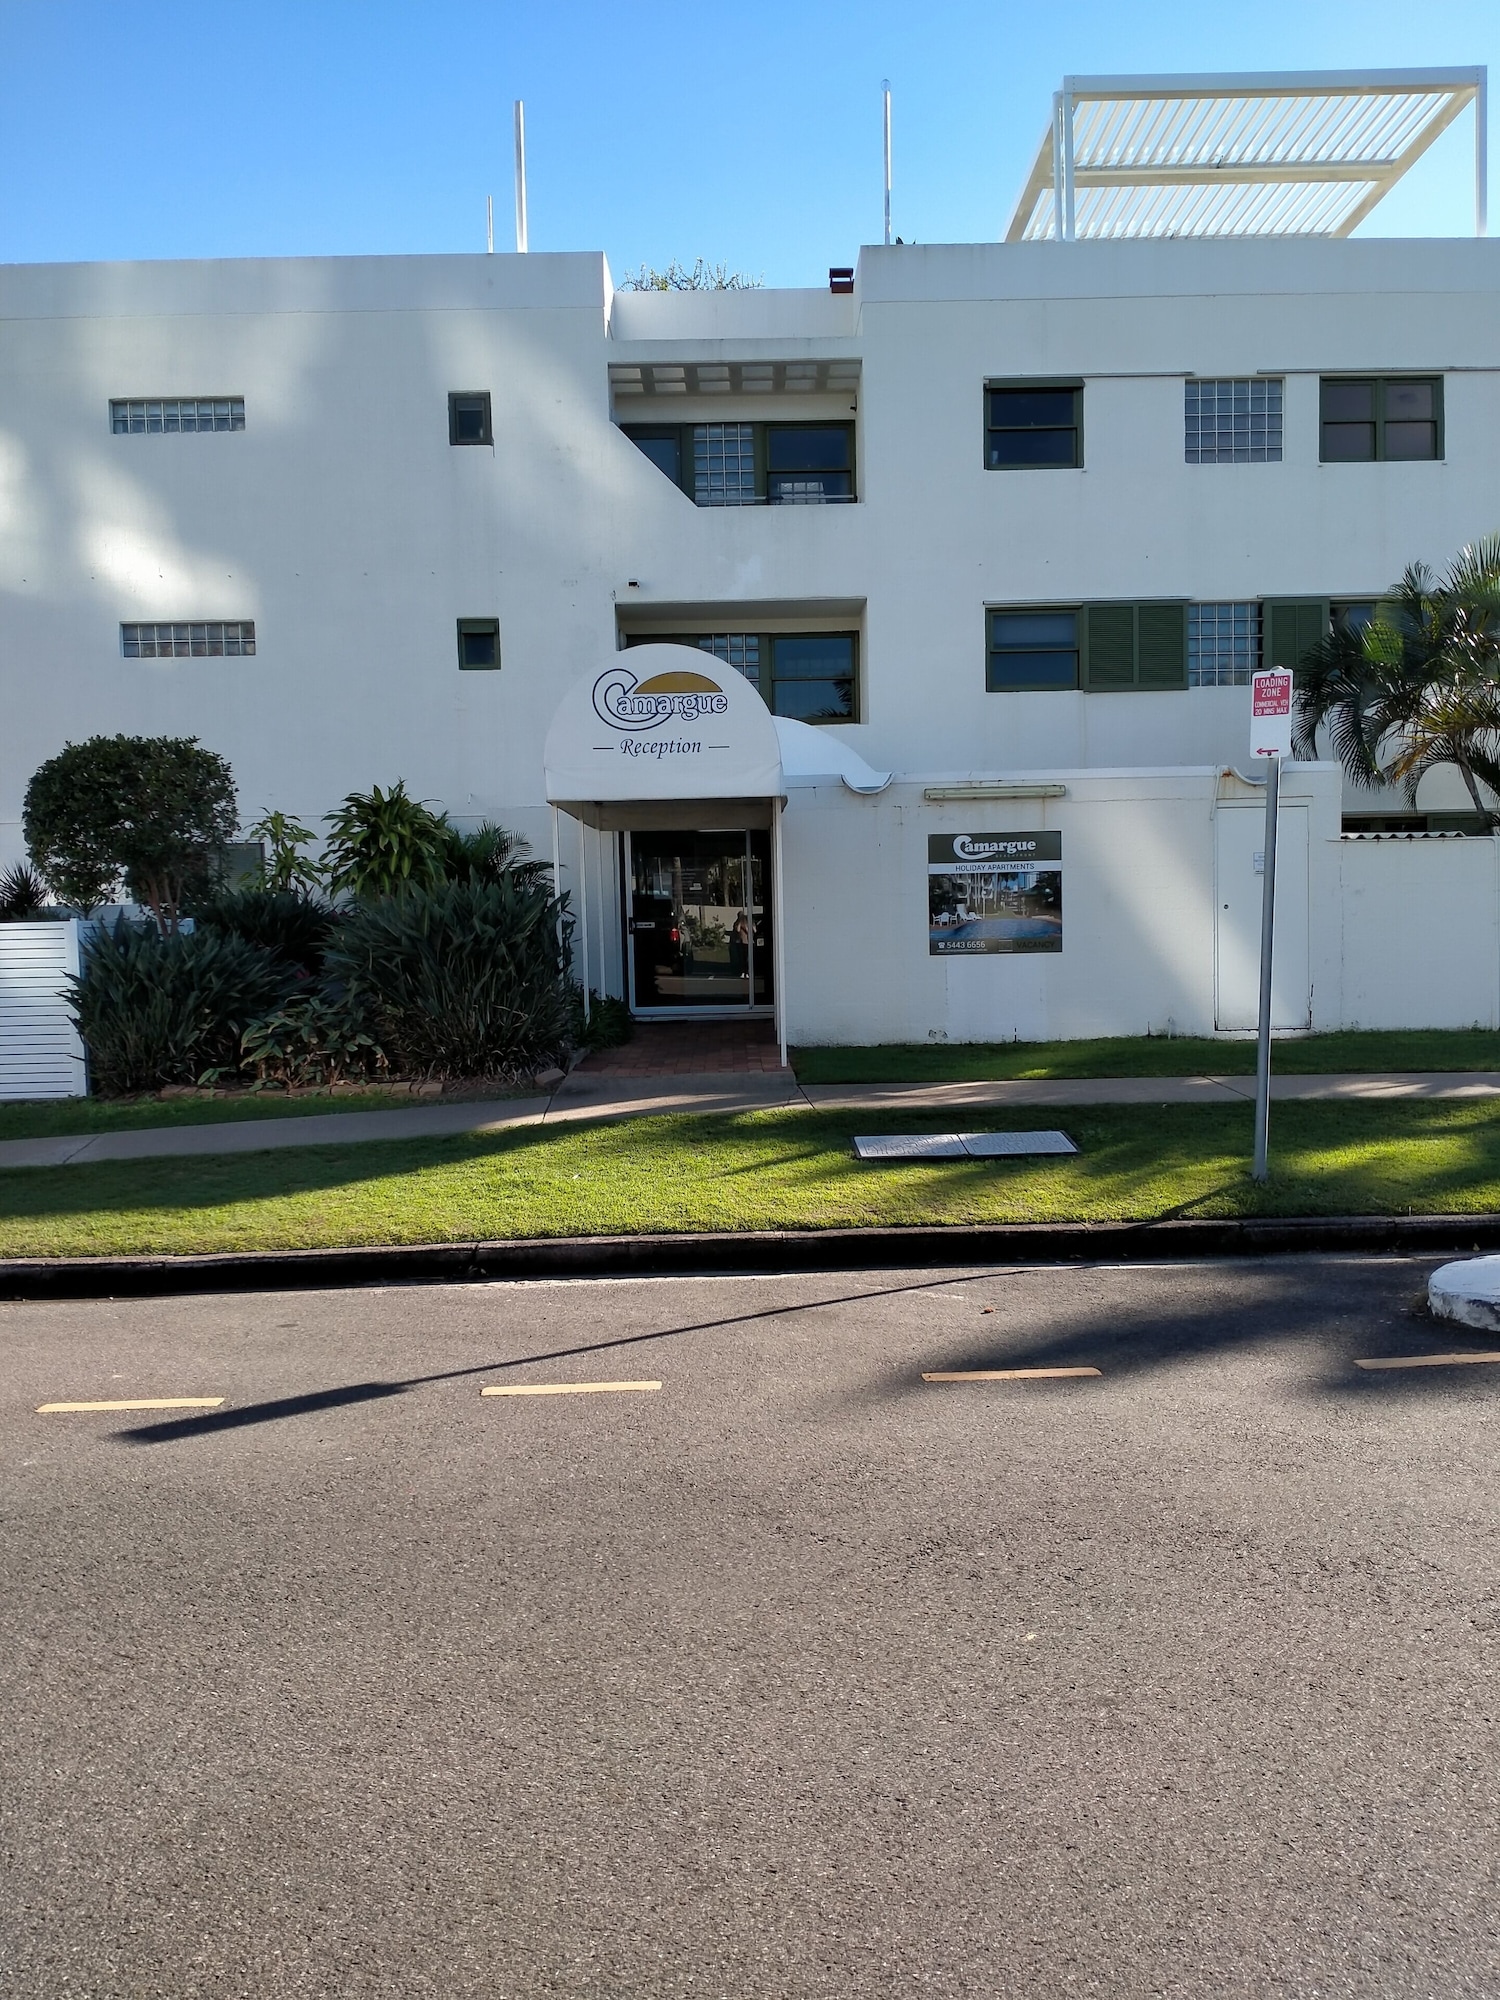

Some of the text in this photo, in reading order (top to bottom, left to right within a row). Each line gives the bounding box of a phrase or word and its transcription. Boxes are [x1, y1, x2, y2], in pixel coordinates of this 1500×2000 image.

[1256, 677, 1288, 688] LOADING
[1262, 687, 1281, 697] ZONE
[592, 668, 728, 731] Camargue
[1255, 700, 1278, 708] COMMERCIAL
[620, 737, 702, 759] Reception
[953, 835, 1037, 860] Camargue
[955, 863, 1035, 872] HOLIDAY APARTMENTS
[946, 941, 966, 949] 5443
[1016, 941, 1055, 949] VACANCY
